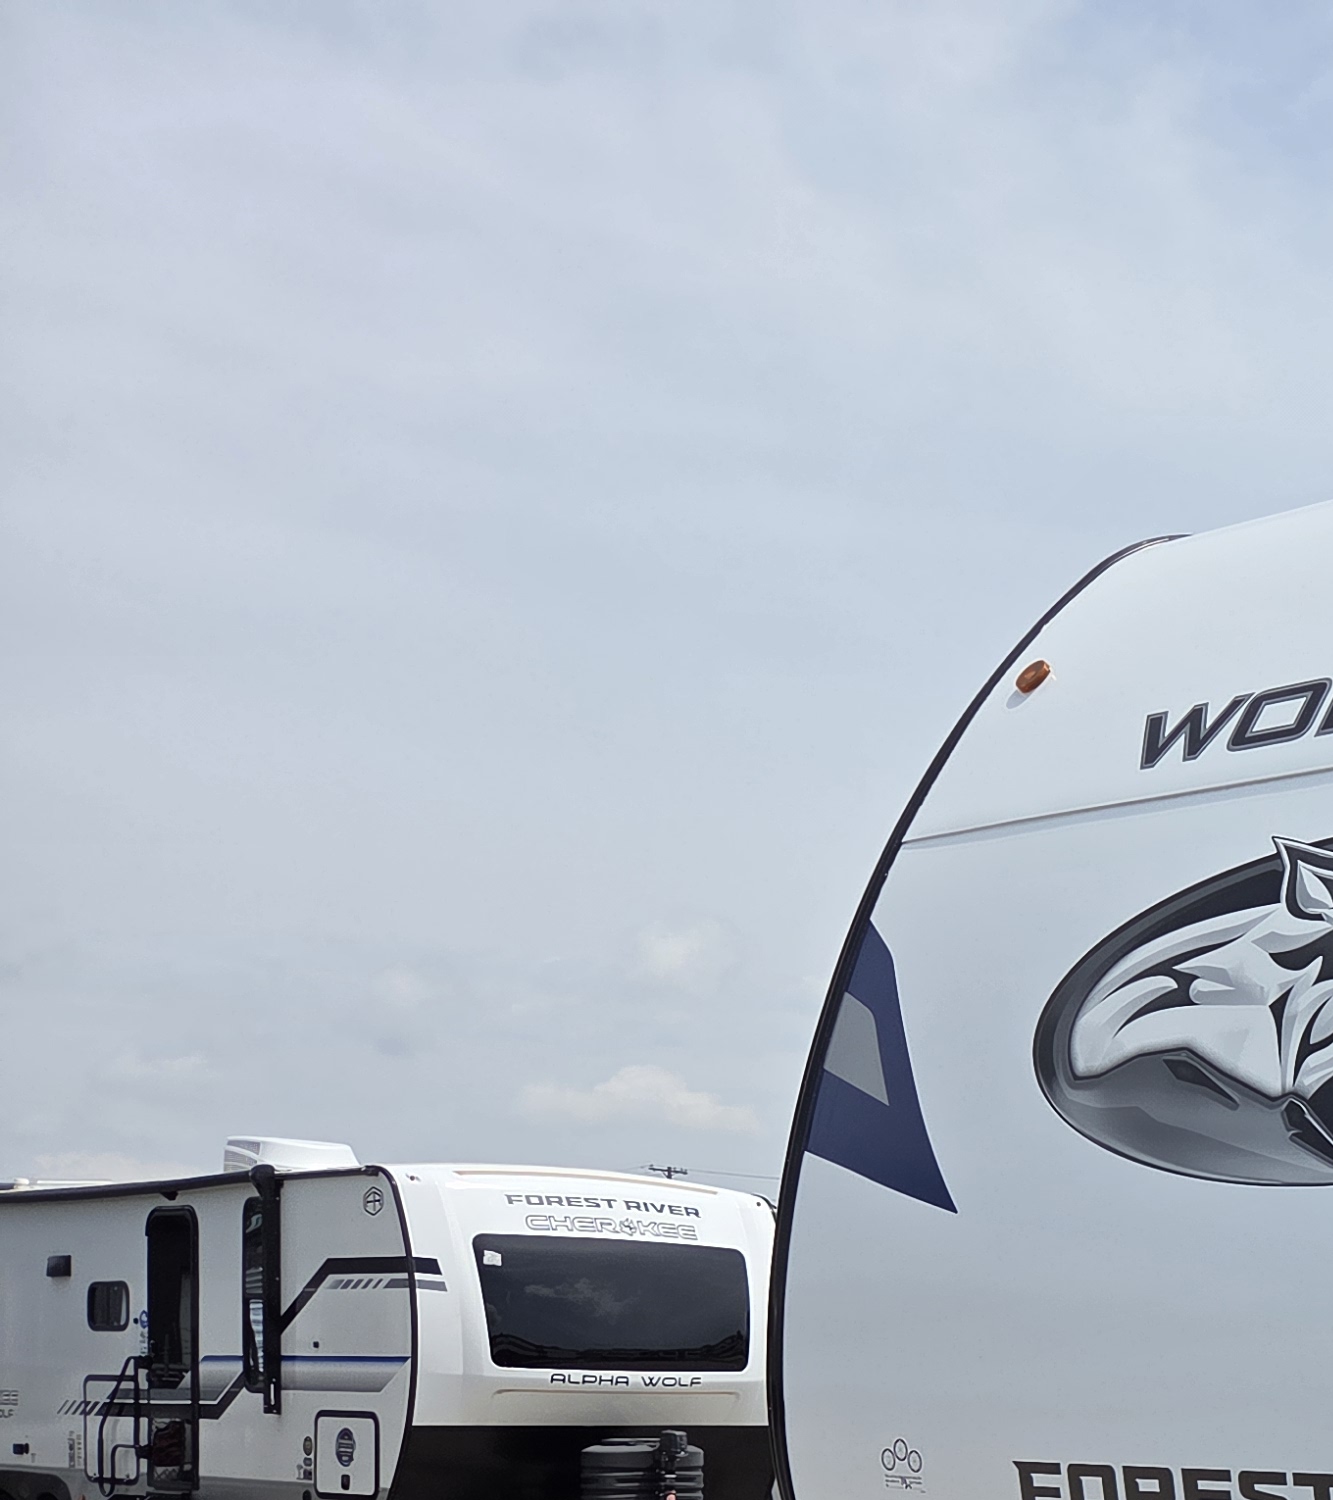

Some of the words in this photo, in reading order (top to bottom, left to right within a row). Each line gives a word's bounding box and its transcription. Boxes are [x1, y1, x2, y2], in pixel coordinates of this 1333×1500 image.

[504, 1194, 617, 1209] FOREST
[623, 1200, 701, 1218] RIVER
[550, 1373, 629, 1386] ALPHA
[641, 1376, 703, 1387] WOLF
